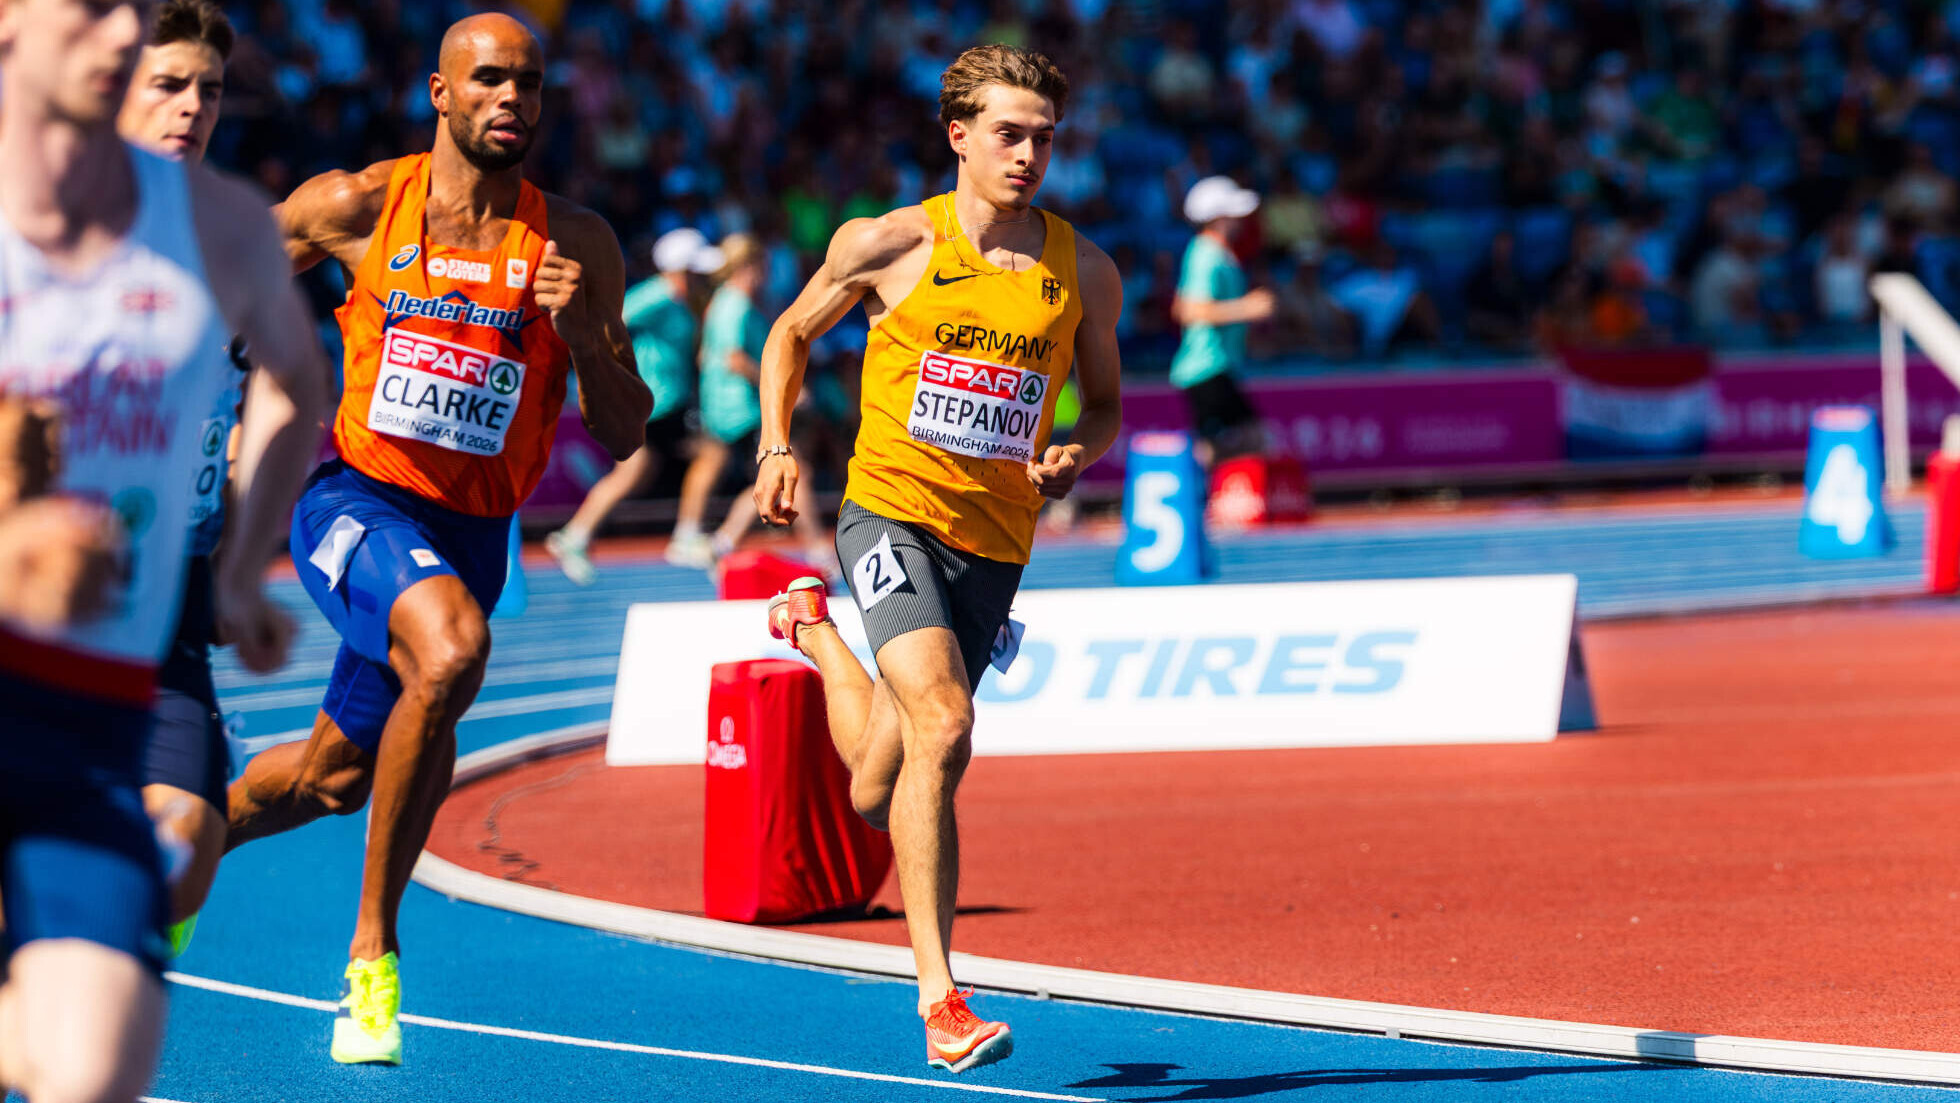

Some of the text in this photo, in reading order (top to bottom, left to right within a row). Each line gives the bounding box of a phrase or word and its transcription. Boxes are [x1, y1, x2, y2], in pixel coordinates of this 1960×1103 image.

[390, 338, 486, 382] SPAR
[936, 323, 1058, 362] GERMANY
[925, 359, 1018, 396] SPAR
[382, 375, 509, 430] CLARKE
[914, 391, 1038, 439] STEPANOV
[375, 411, 498, 452] BIRMINGHAM 2026
[912, 426, 1002, 455] BIRMINGHAM
[1809, 443, 1873, 546] 4
[1131, 471, 1185, 573] 5
[865, 553, 892, 594] 2
[1083, 630, 1420, 700] TIRES
